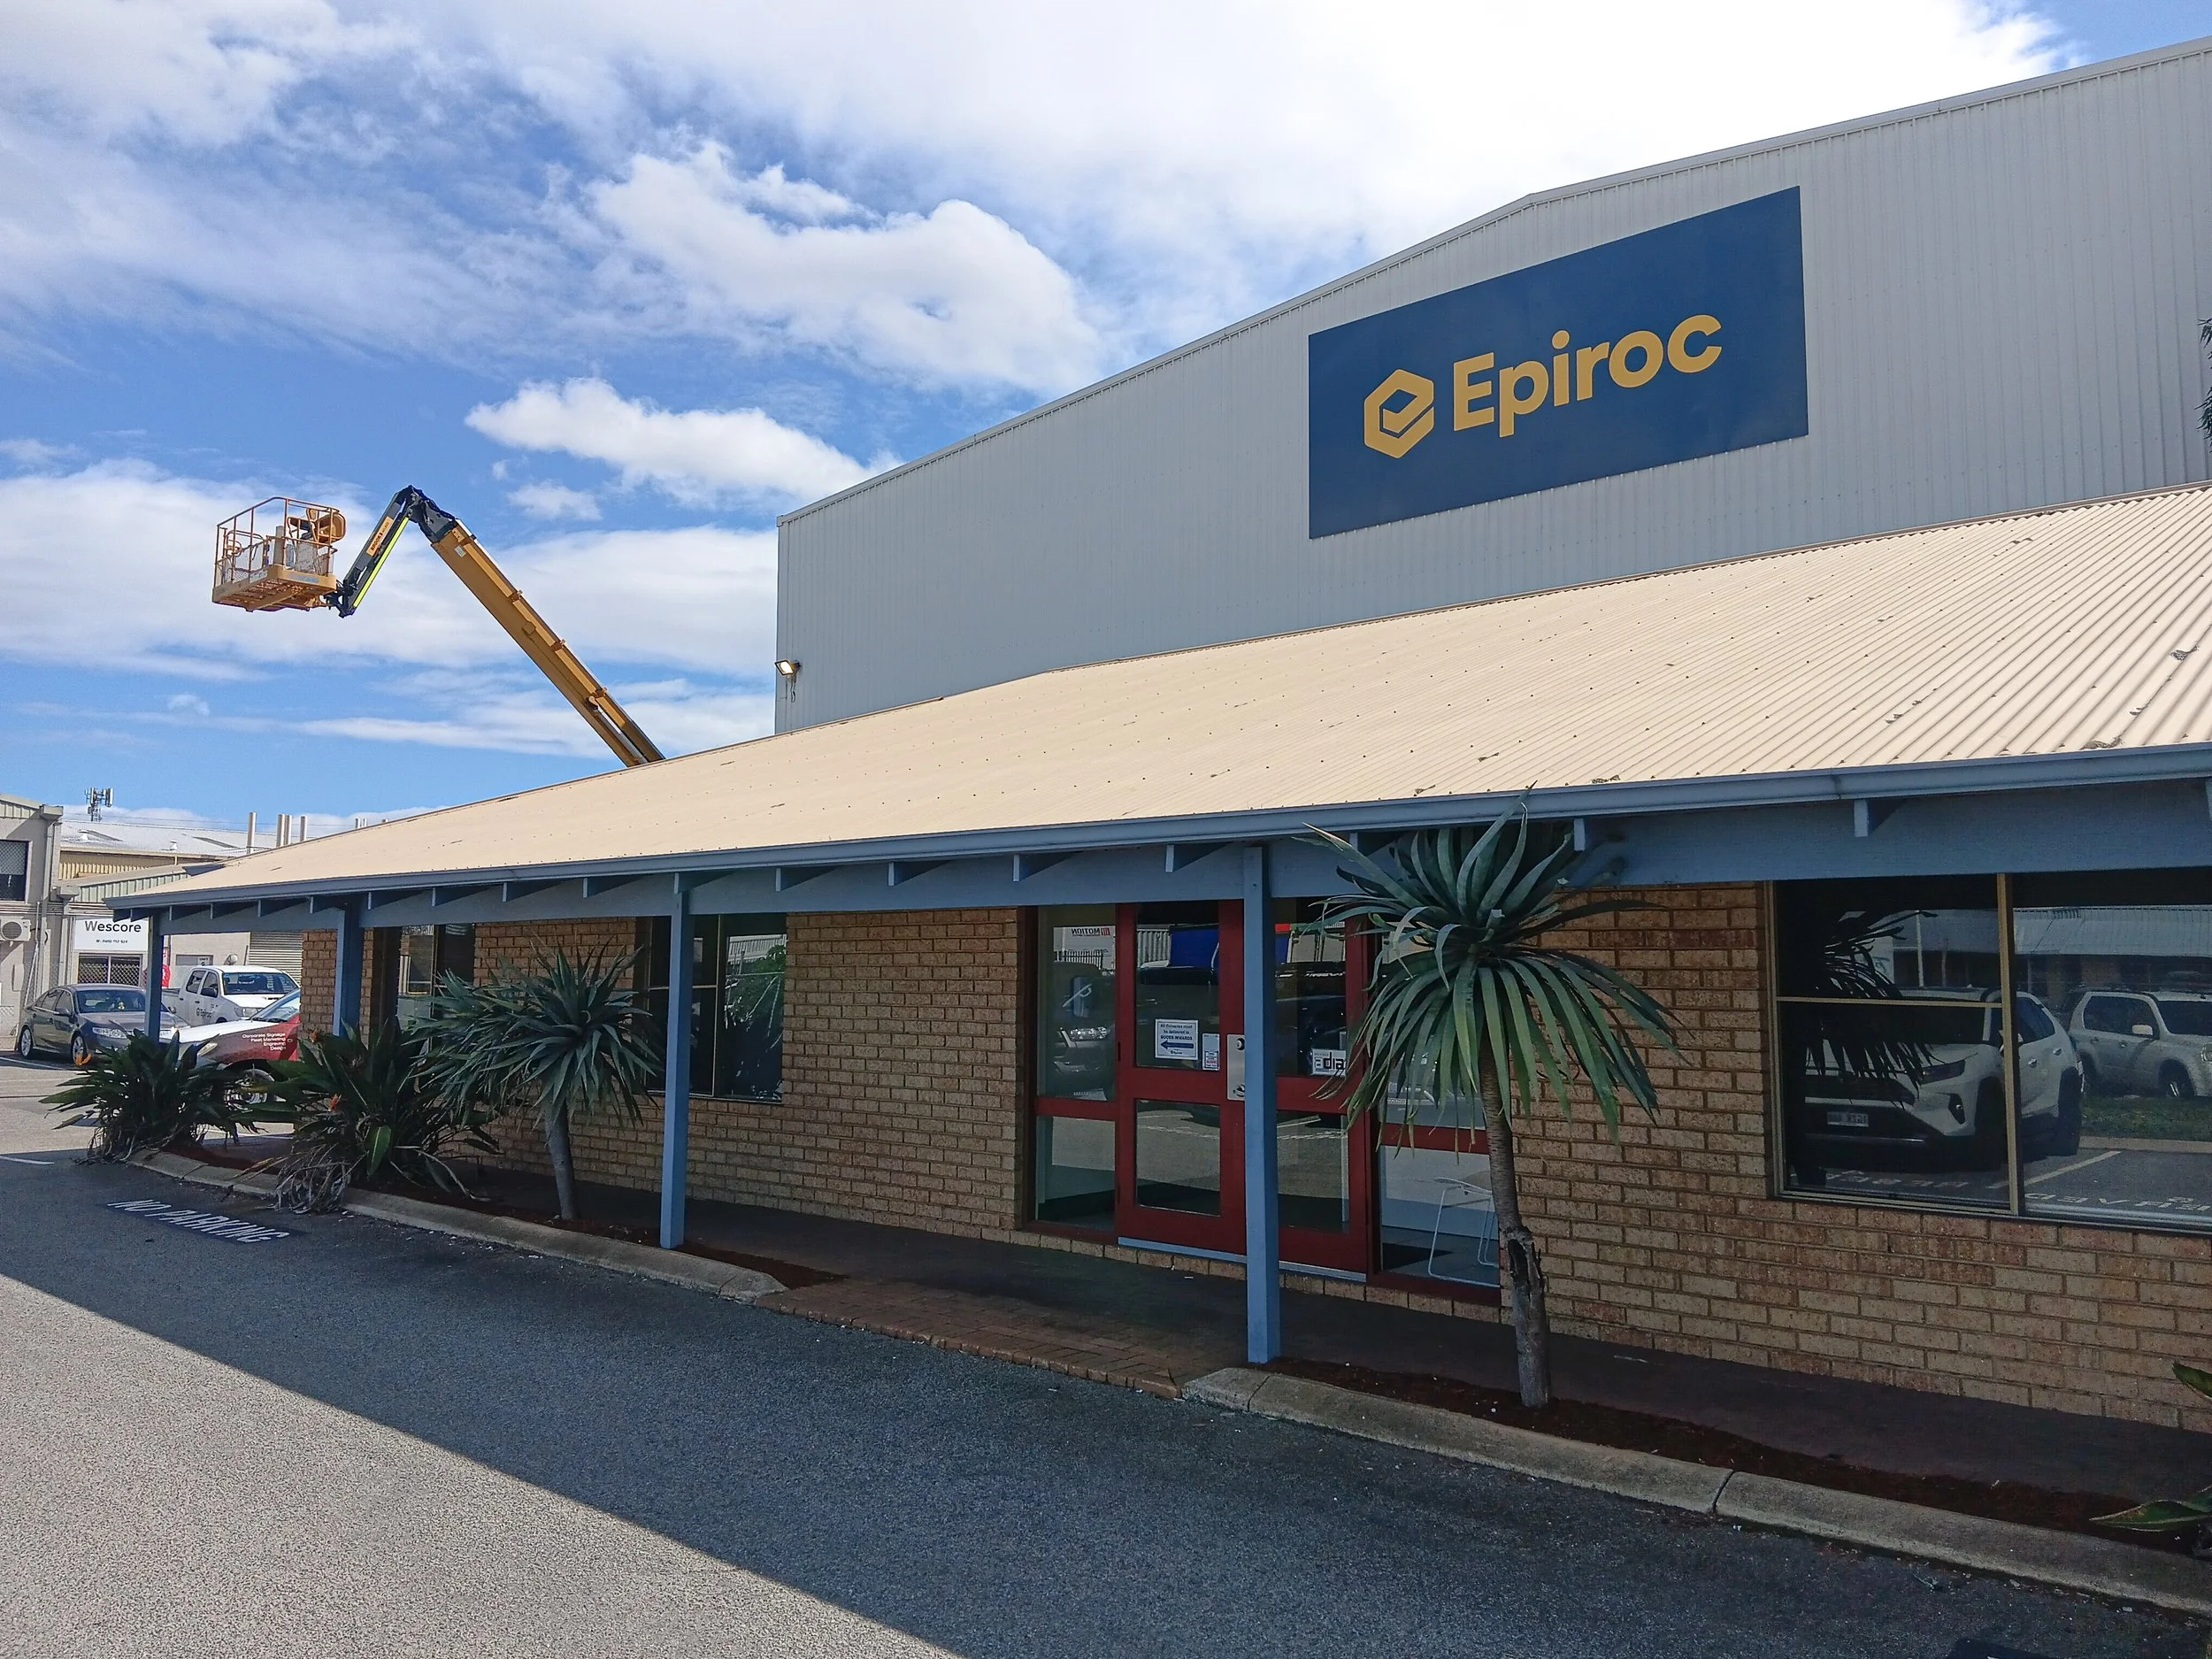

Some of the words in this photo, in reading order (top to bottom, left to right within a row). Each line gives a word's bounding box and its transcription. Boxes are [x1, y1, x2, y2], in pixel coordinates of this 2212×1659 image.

[1454, 314, 1722, 438] Epiroc
[85, 920, 142, 933] Wescore
[107, 1200, 172, 1211] NO
[143, 1210, 290, 1243] PARKING
